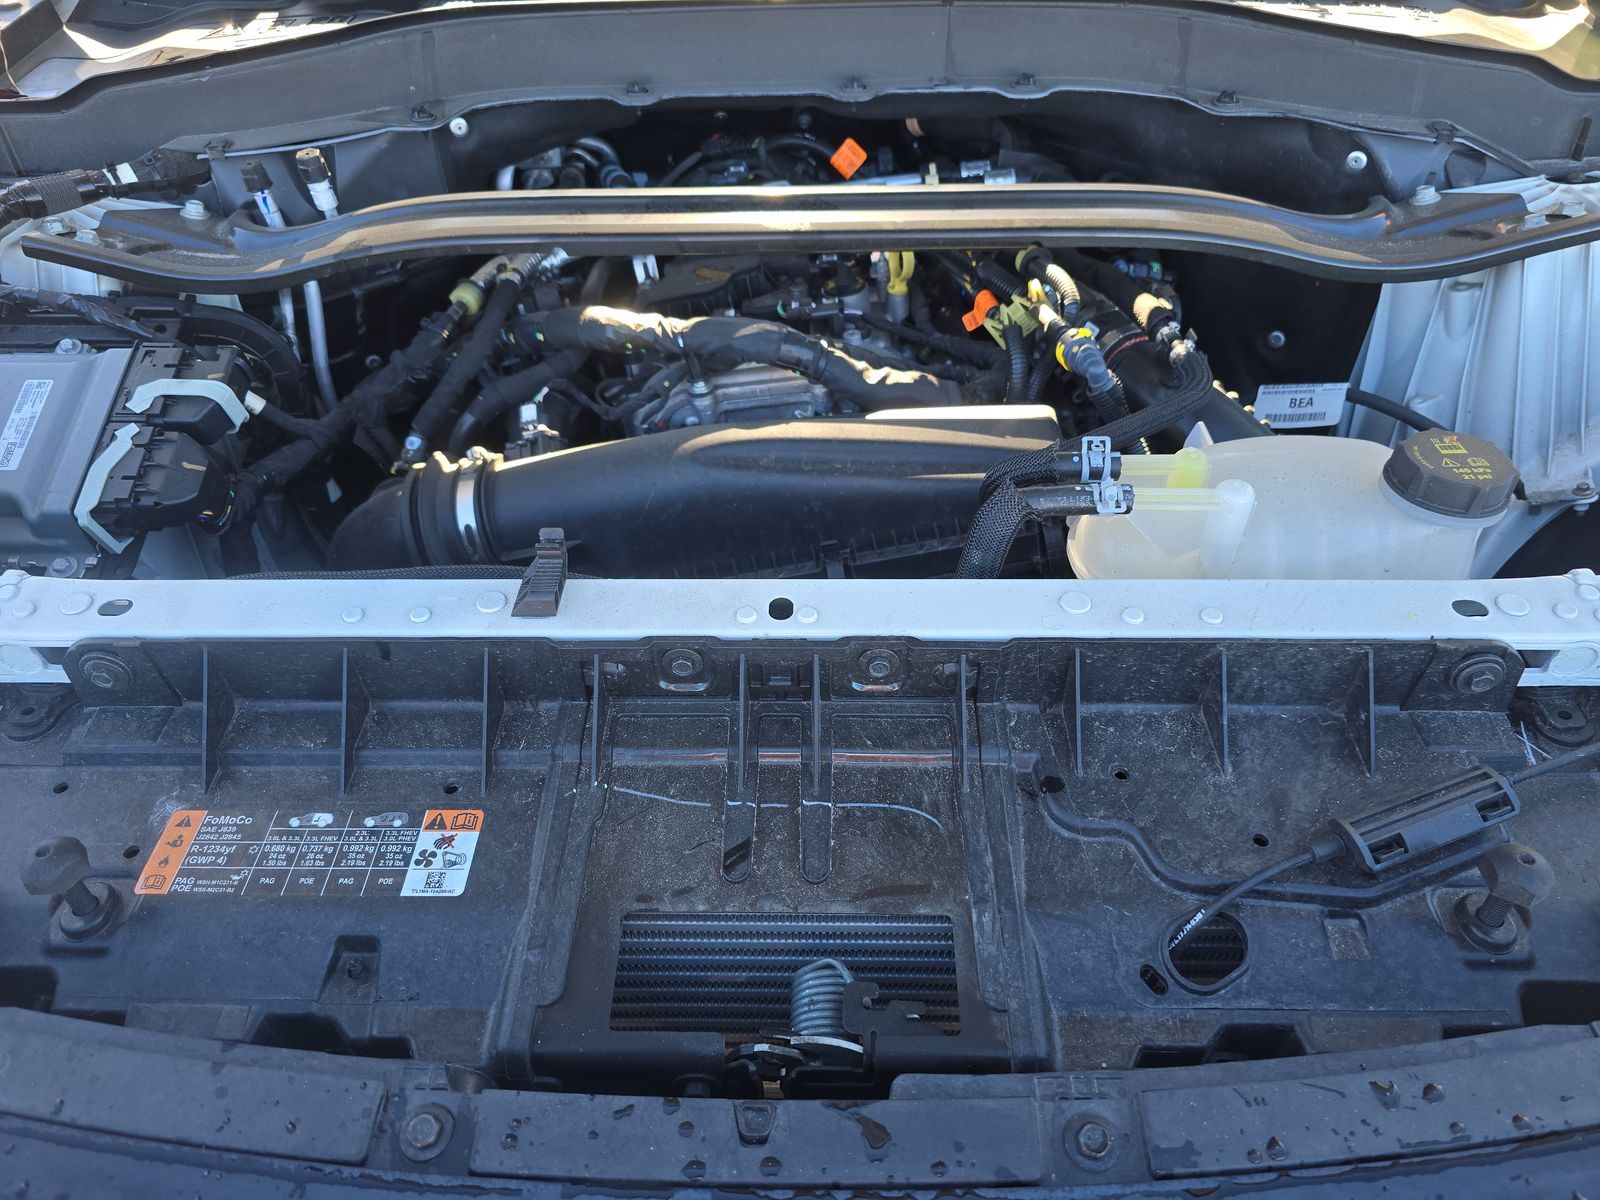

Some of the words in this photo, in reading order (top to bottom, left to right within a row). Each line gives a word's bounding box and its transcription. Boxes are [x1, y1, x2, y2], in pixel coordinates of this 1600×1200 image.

[1288, 397, 1314, 409] BEA
[0, 442, 17, 467] FoMoCo
[203, 815, 253, 825] FoMoCo
[190, 845, 237, 855] R-1234yf
[286, 845, 297, 853] kg
[323, 845, 334, 853] kg
[364, 845, 375, 853] kg
[402, 845, 413, 853] kg
[184, 856, 216, 866] (GWP
[216, 856, 227, 866] 4)
[174, 877, 196, 885] PAG
[170, 884, 193, 892] POE
